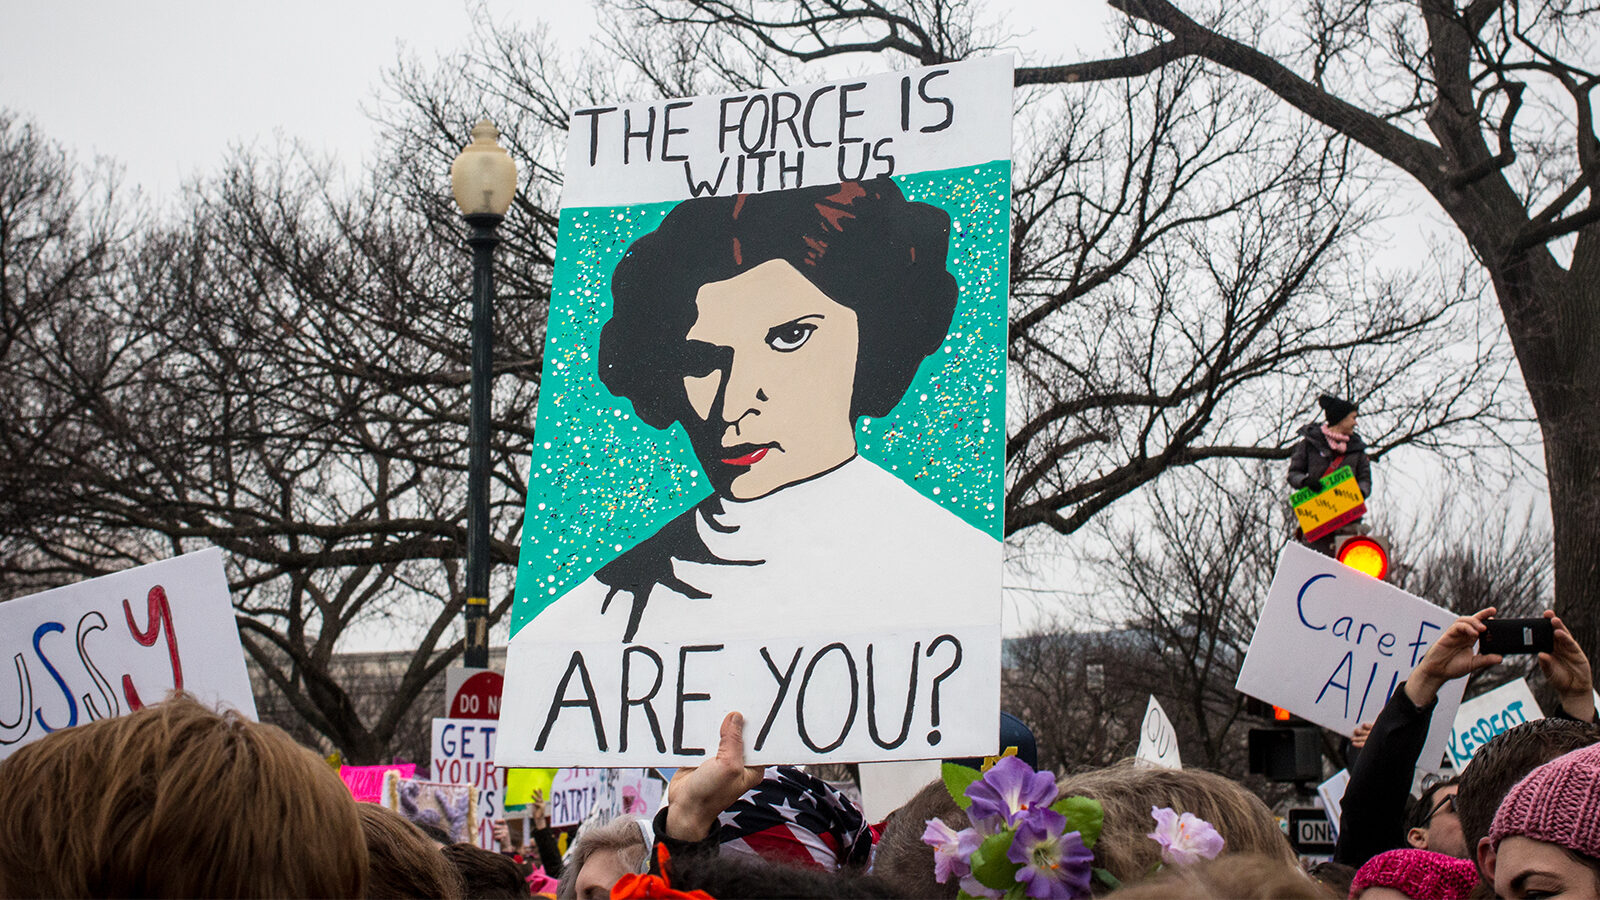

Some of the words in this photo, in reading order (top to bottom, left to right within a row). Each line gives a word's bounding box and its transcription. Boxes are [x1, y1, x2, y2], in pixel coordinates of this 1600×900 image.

[574, 101, 694, 166] THE
[718, 82, 868, 155] FORCE
[900, 69, 955, 133] IS
[684, 150, 806, 198] WITH
[837, 137, 896, 183] US
[1297, 573, 1396, 656] Care
[1408, 620, 1442, 668] F
[460, 693, 480, 714] DO
[487, 695, 502, 715] N
[534, 644, 724, 756] ARE
[754, 634, 962, 754] YOU?
[1315, 650, 1399, 724] All
[435, 758, 498, 791] YOUR
[441, 723, 497, 760] GET
